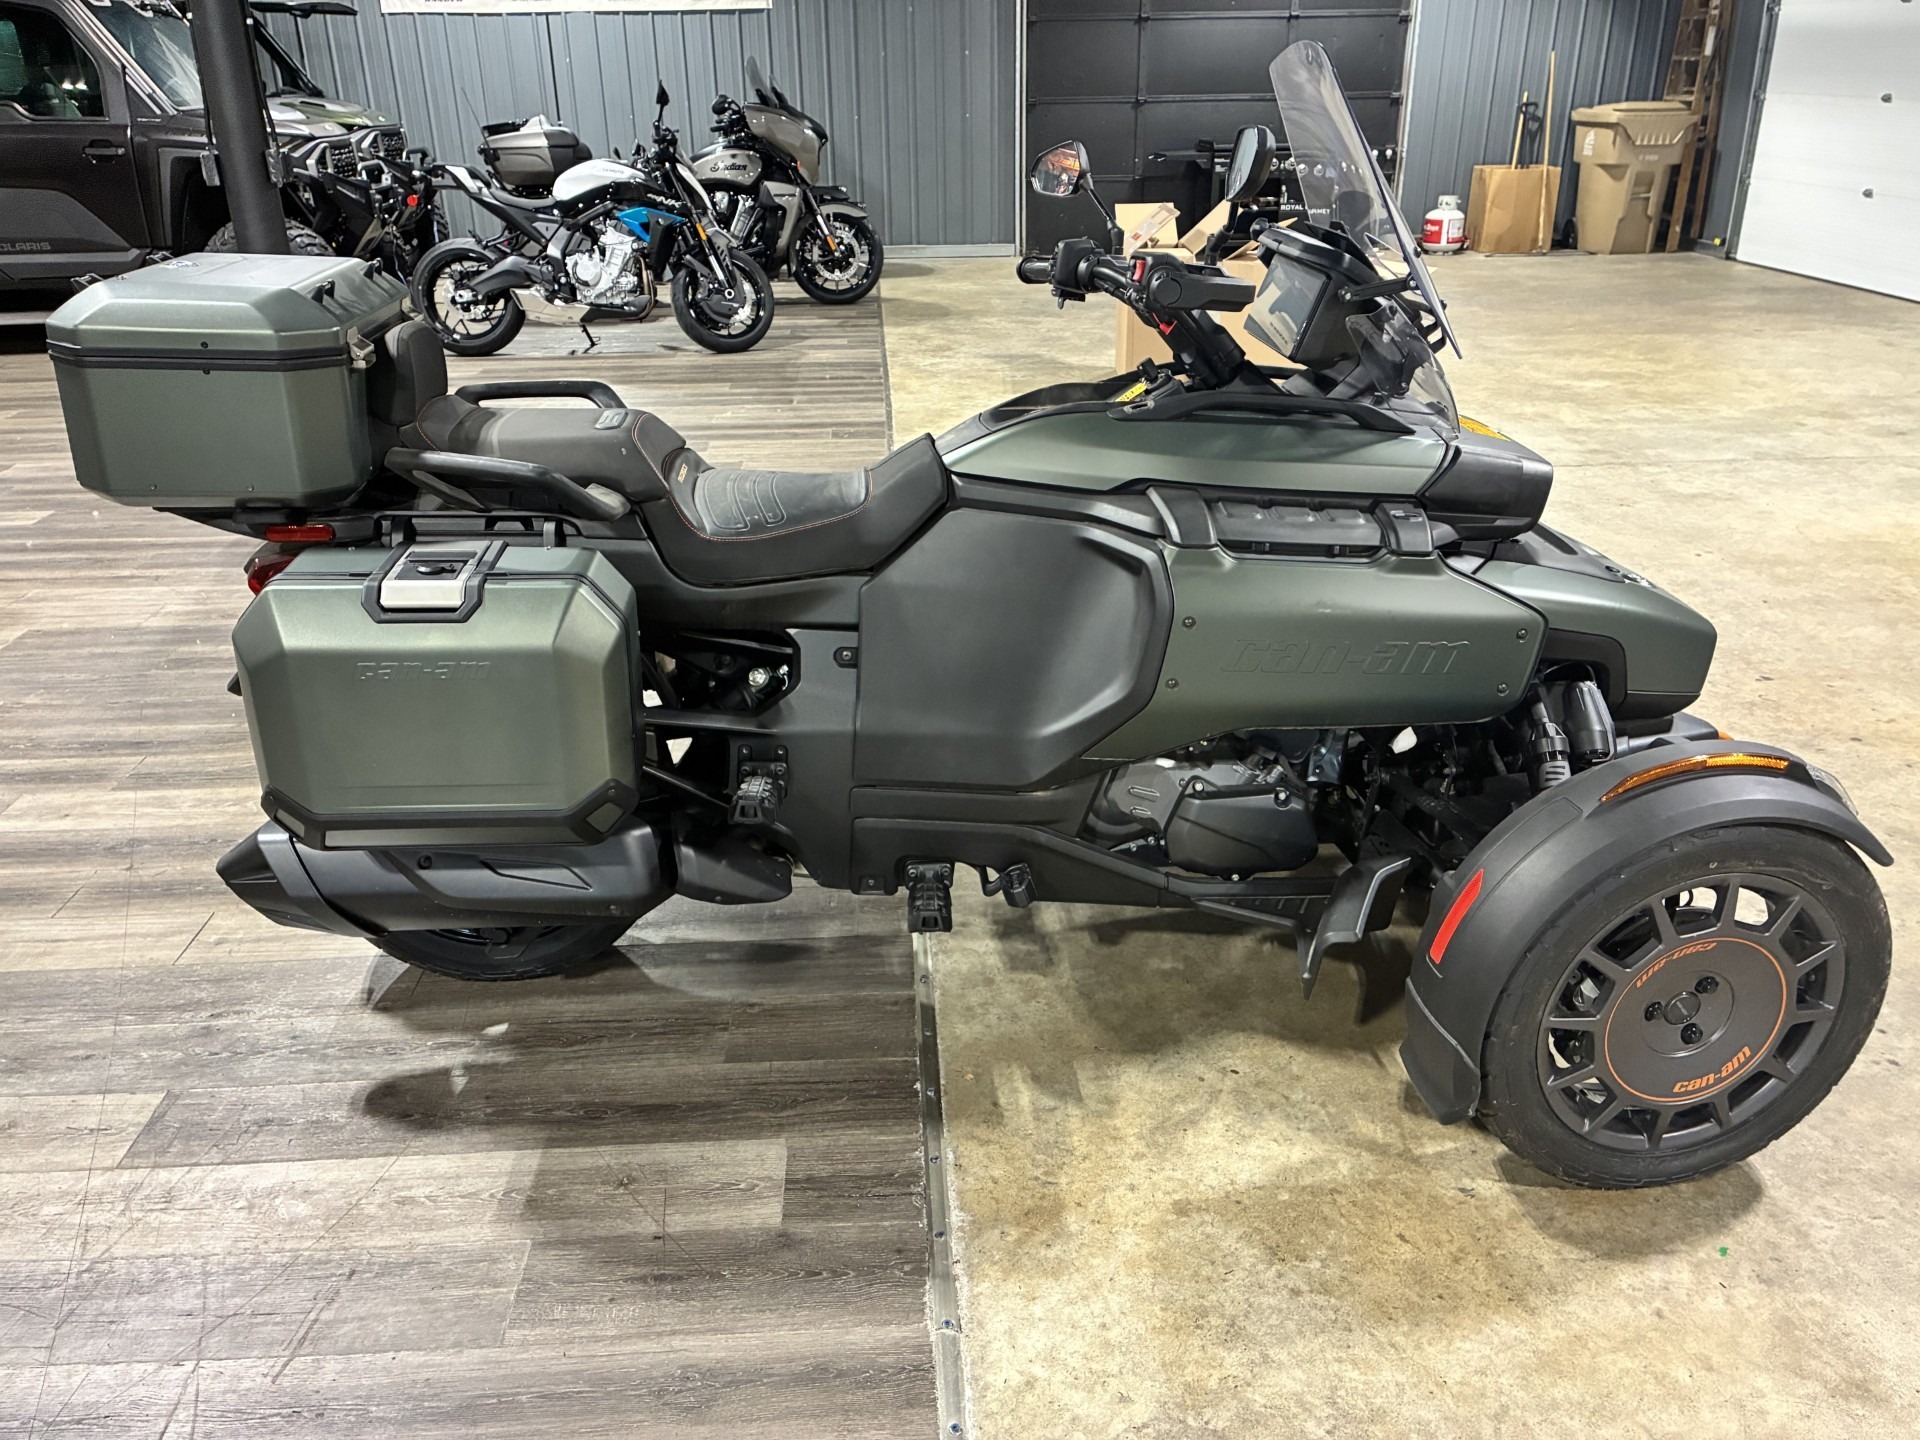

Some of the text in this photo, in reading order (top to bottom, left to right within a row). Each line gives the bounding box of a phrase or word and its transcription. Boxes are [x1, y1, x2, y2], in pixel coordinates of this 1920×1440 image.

[710, 160, 748, 172] Indian
[355, 661, 492, 680] can-am
[1219, 639, 1470, 675] can-am
[1635, 942, 1718, 989] can-am
[1672, 1045, 1751, 1094] can-am
